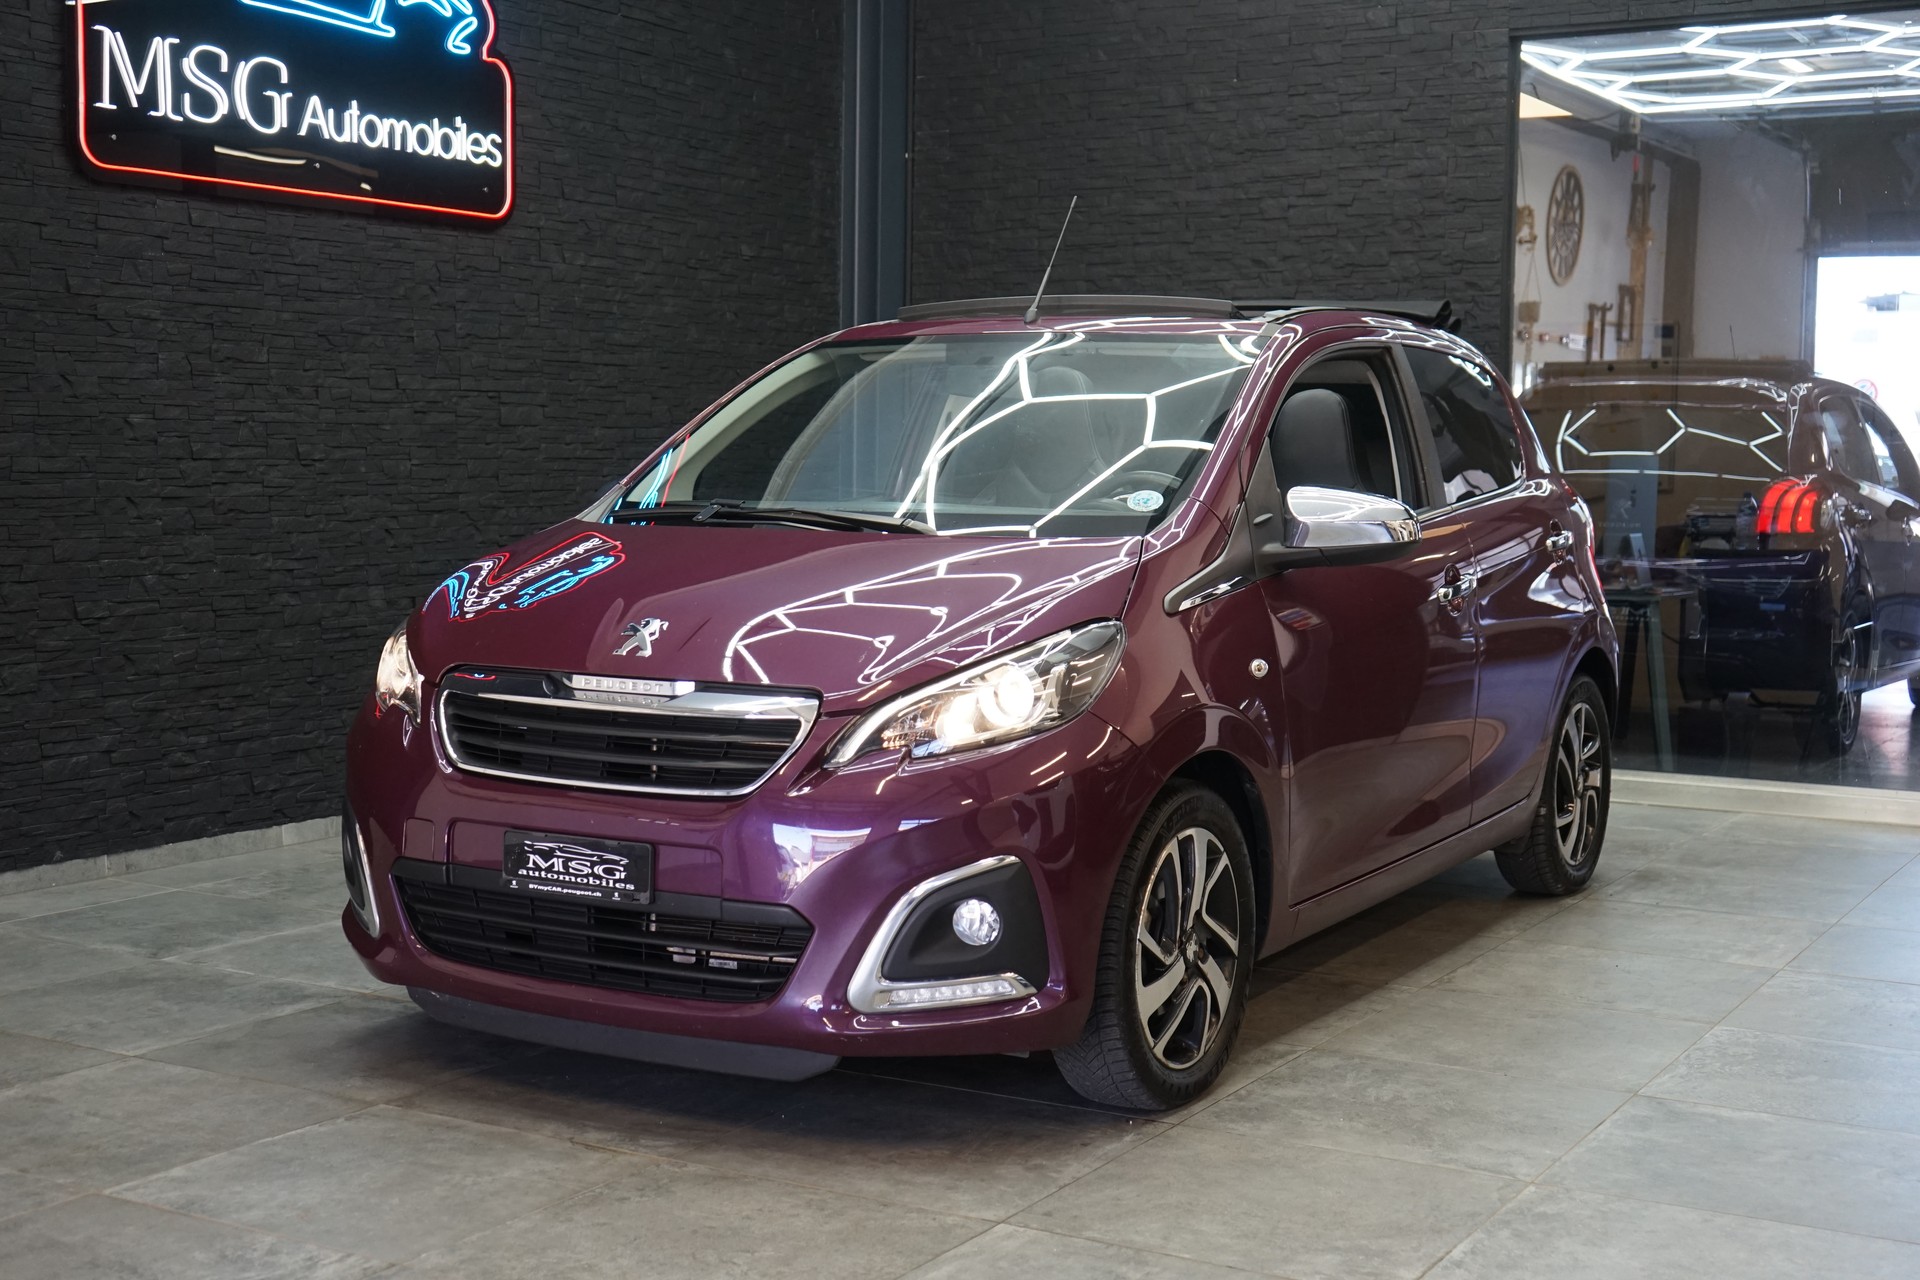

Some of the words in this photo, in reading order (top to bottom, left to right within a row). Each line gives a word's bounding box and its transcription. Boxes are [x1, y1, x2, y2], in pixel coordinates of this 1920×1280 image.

[91, 24, 293, 134] MSG
[297, 94, 502, 168] Automobiles
[581, 677, 664, 693] PEUGEOT
[526, 853, 627, 880] MSG
[517, 868, 635, 891] automobiles
